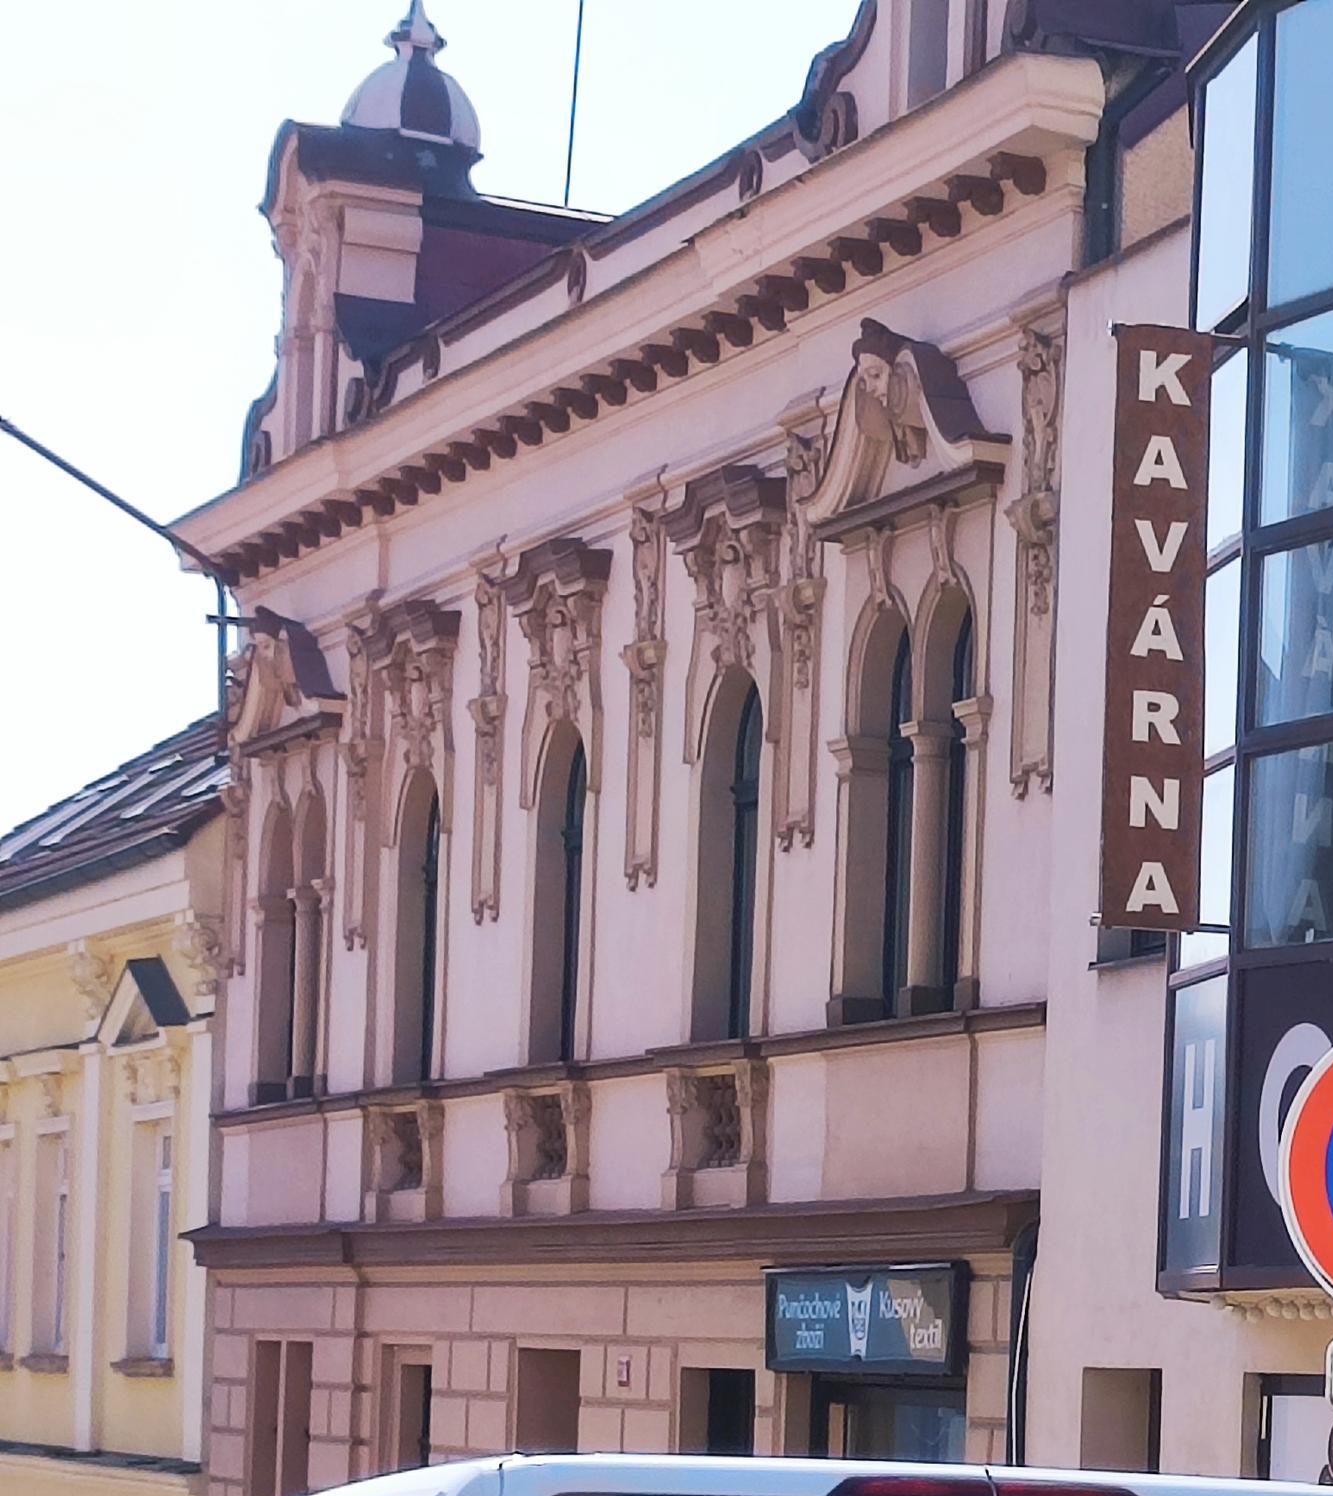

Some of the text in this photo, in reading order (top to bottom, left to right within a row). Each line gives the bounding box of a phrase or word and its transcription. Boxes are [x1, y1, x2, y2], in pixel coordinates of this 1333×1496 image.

[1126, 350, 1192, 915] KAVÁRNA
[879, 1289, 924, 1324] Kusový
[910, 1318, 943, 1350] textil
